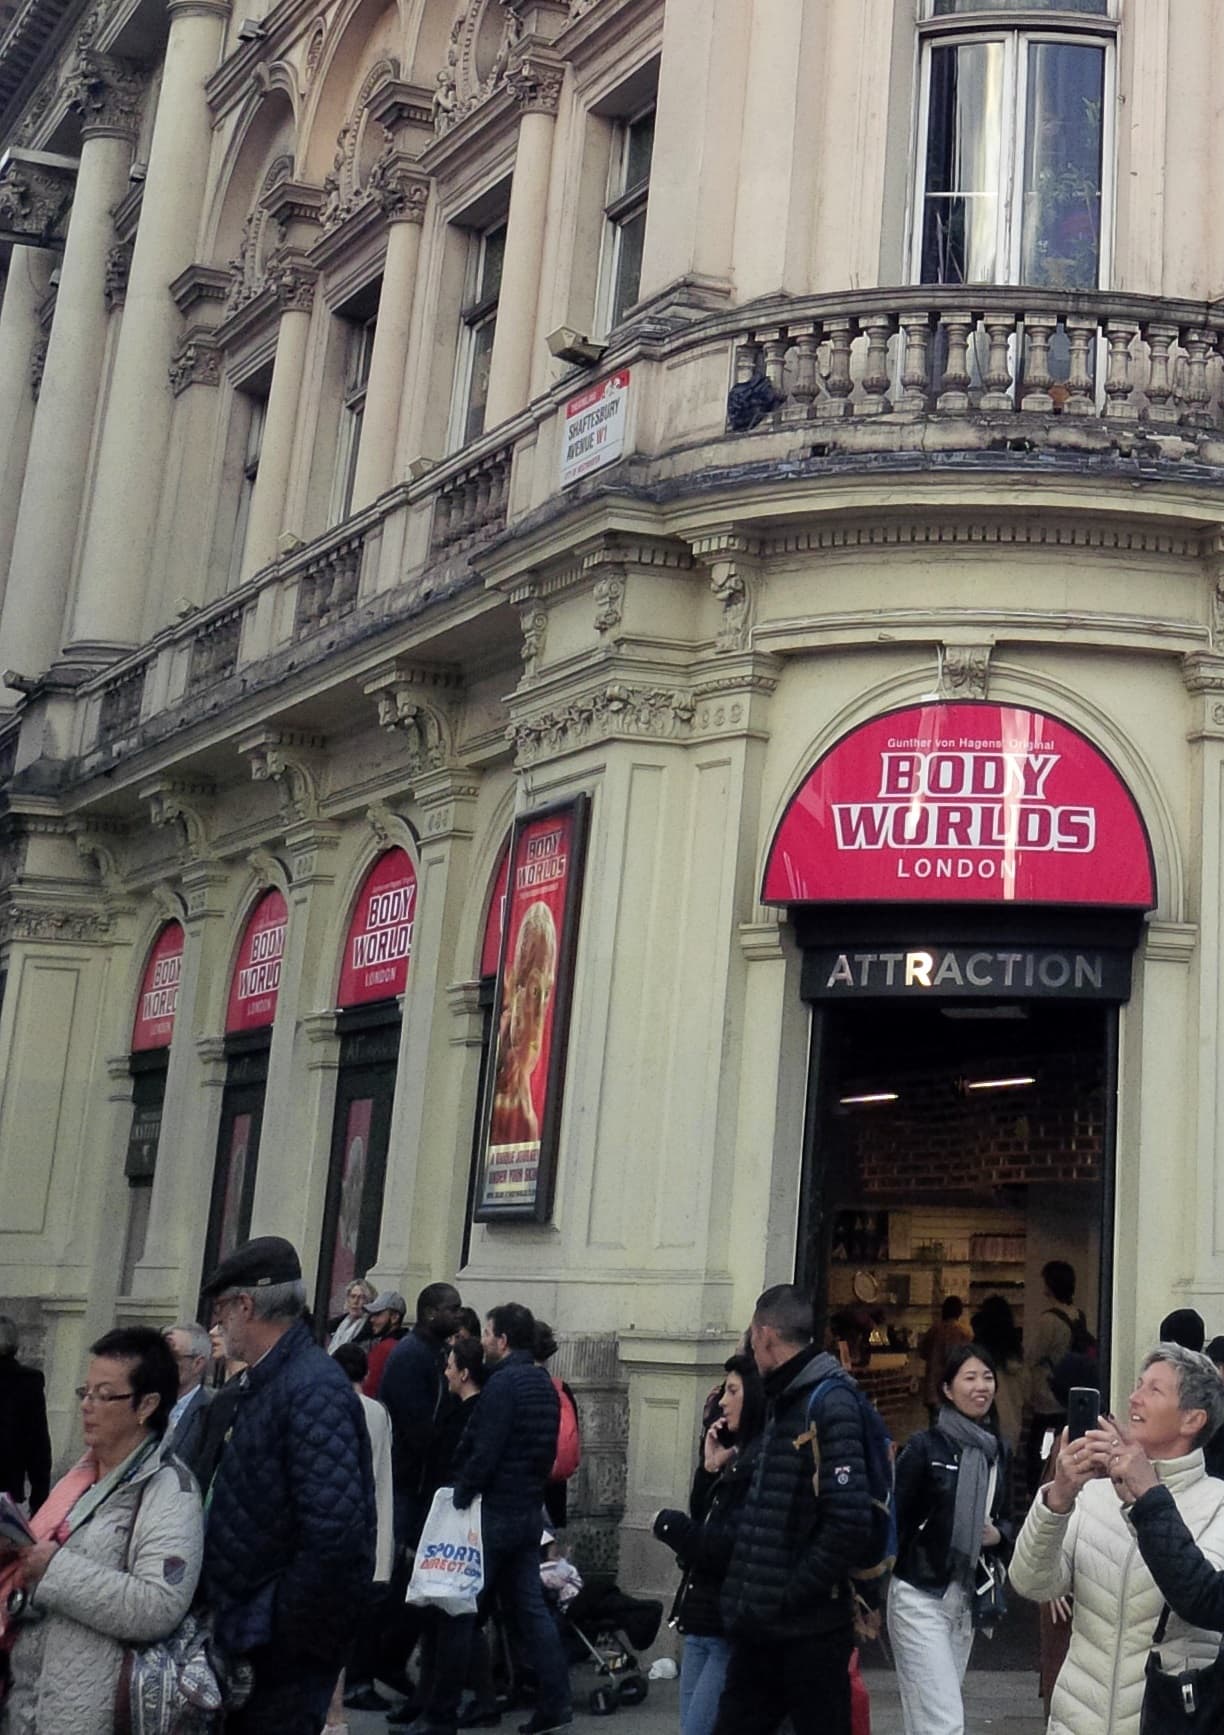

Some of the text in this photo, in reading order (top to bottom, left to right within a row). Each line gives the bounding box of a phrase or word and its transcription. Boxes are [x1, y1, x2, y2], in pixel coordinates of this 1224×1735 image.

[568, 397, 620, 440] SHAFTESBURY
[566, 424, 607, 460] AVENUE W1
[877, 752, 1061, 800] BODY
[527, 831, 562, 863] BODY
[832, 802, 1096, 853] WORLDS
[517, 854, 567, 890] WORLDS
[897, 859, 1016, 878] LONDON
[365, 885, 415, 930] BODY
[238, 958, 283, 999] WORLD
[826, 951, 1103, 988] ATTRACTION
